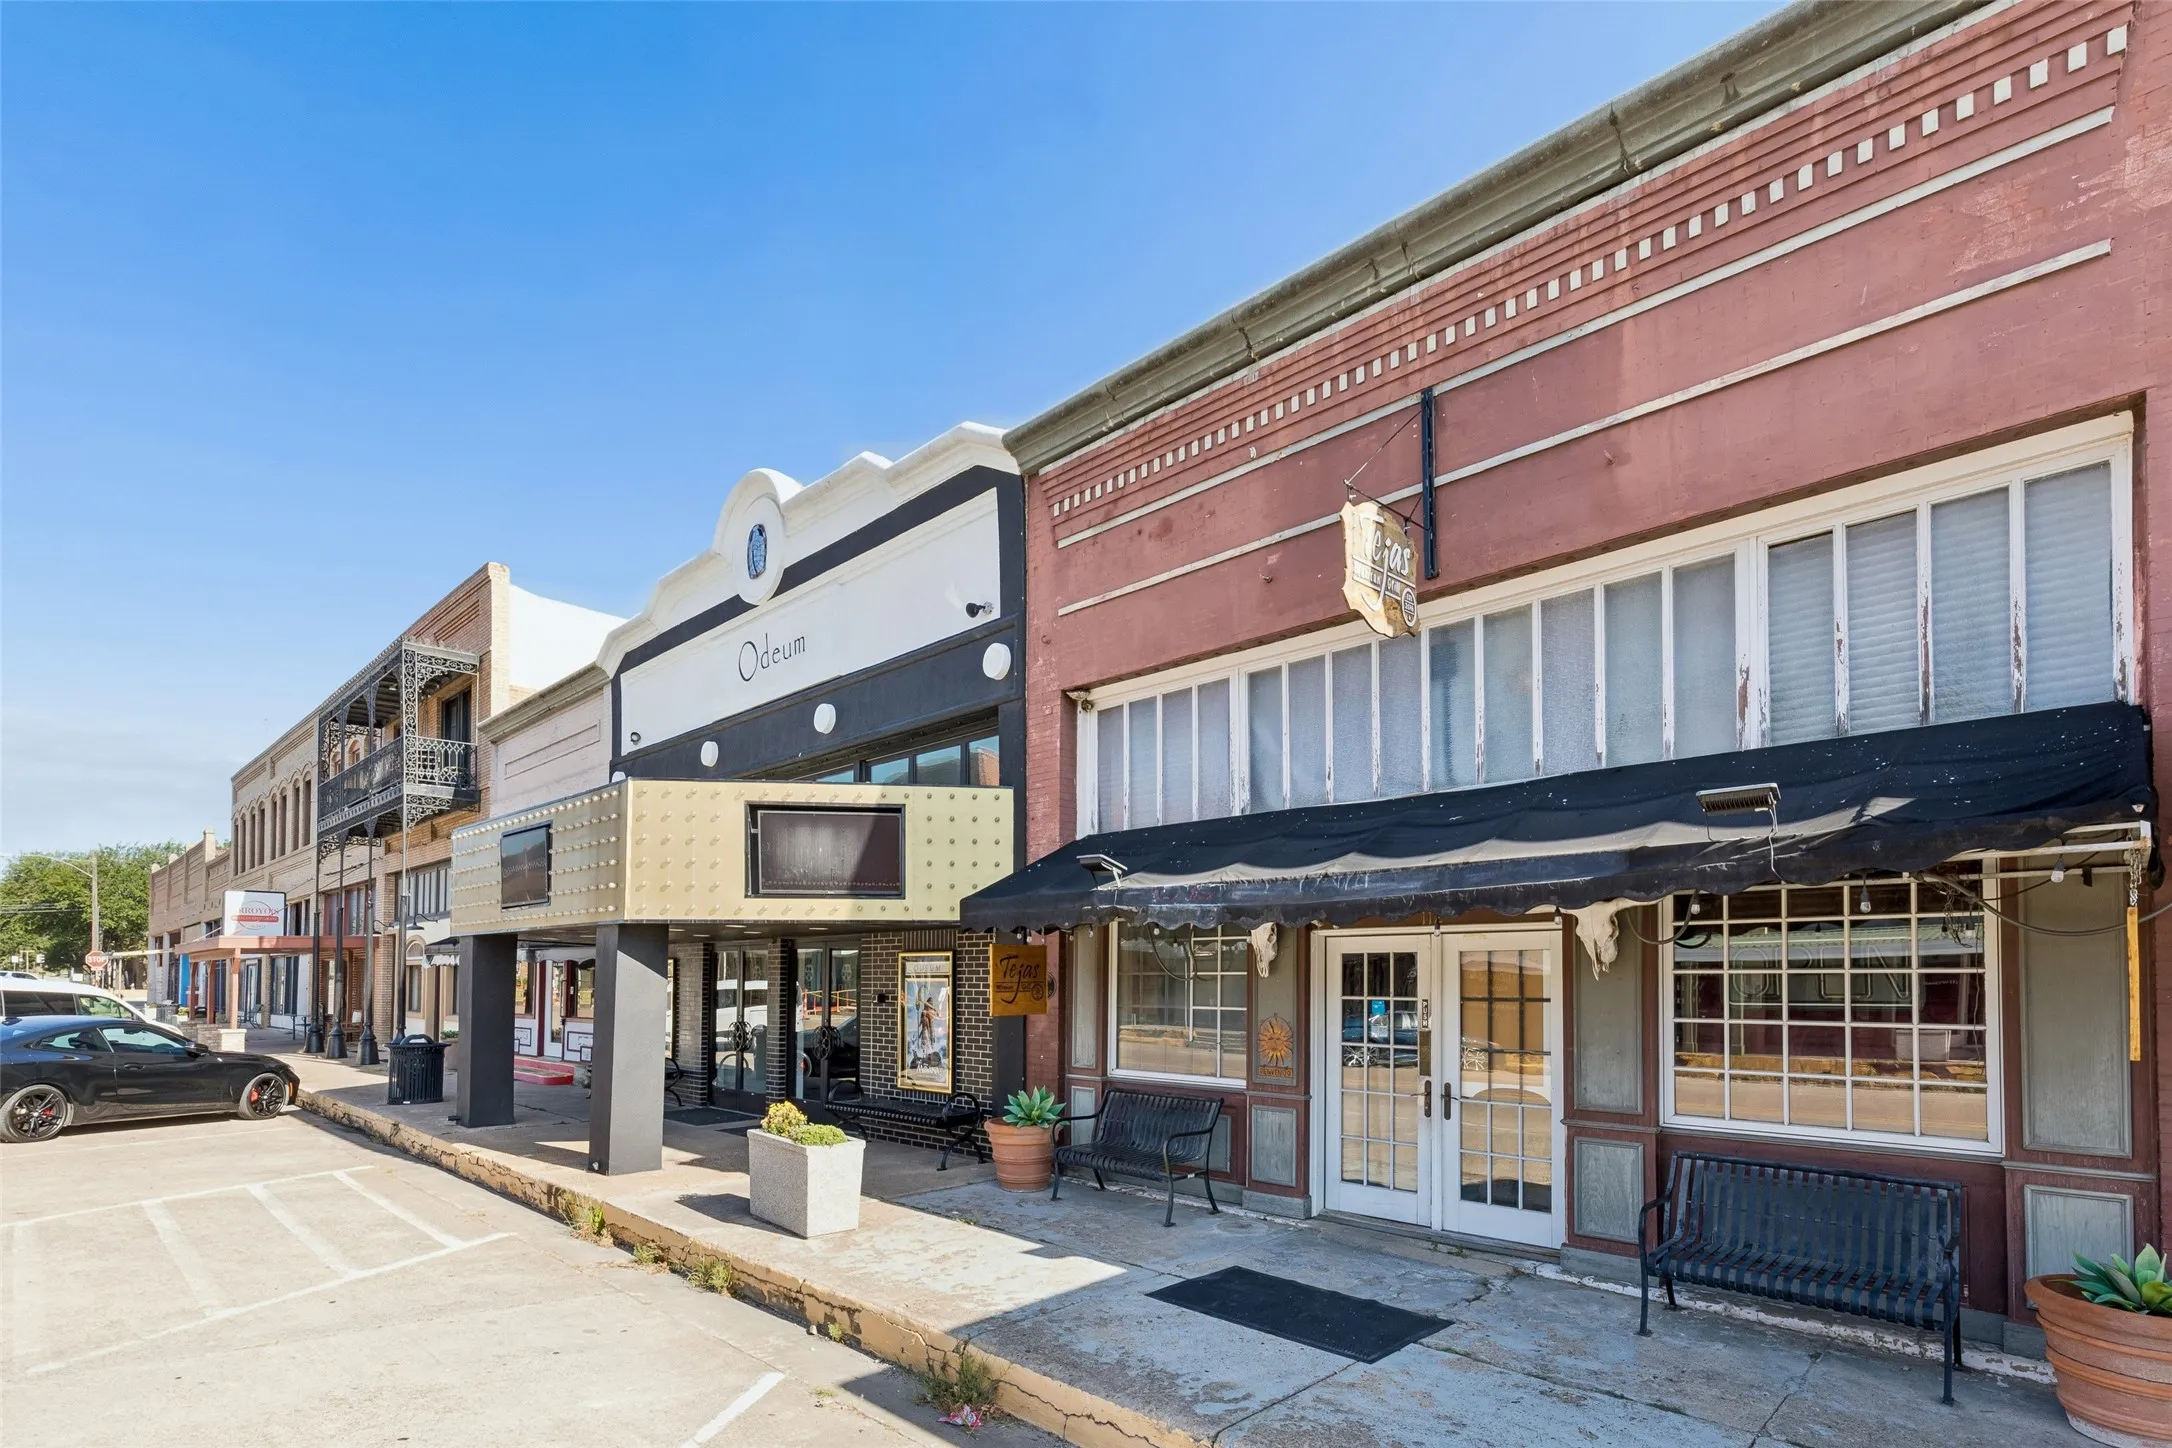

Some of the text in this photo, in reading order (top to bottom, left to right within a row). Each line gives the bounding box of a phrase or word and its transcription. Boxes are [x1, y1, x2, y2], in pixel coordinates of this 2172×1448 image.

[1359, 510, 1411, 612] Tejas
[738, 632, 805, 682] Odeum
[233, 906, 281, 915] RROYO'S
[87, 954, 107, 963] STOP
[999, 954, 1040, 1004] Tejas
[1732, 945, 1910, 999] OPEN
